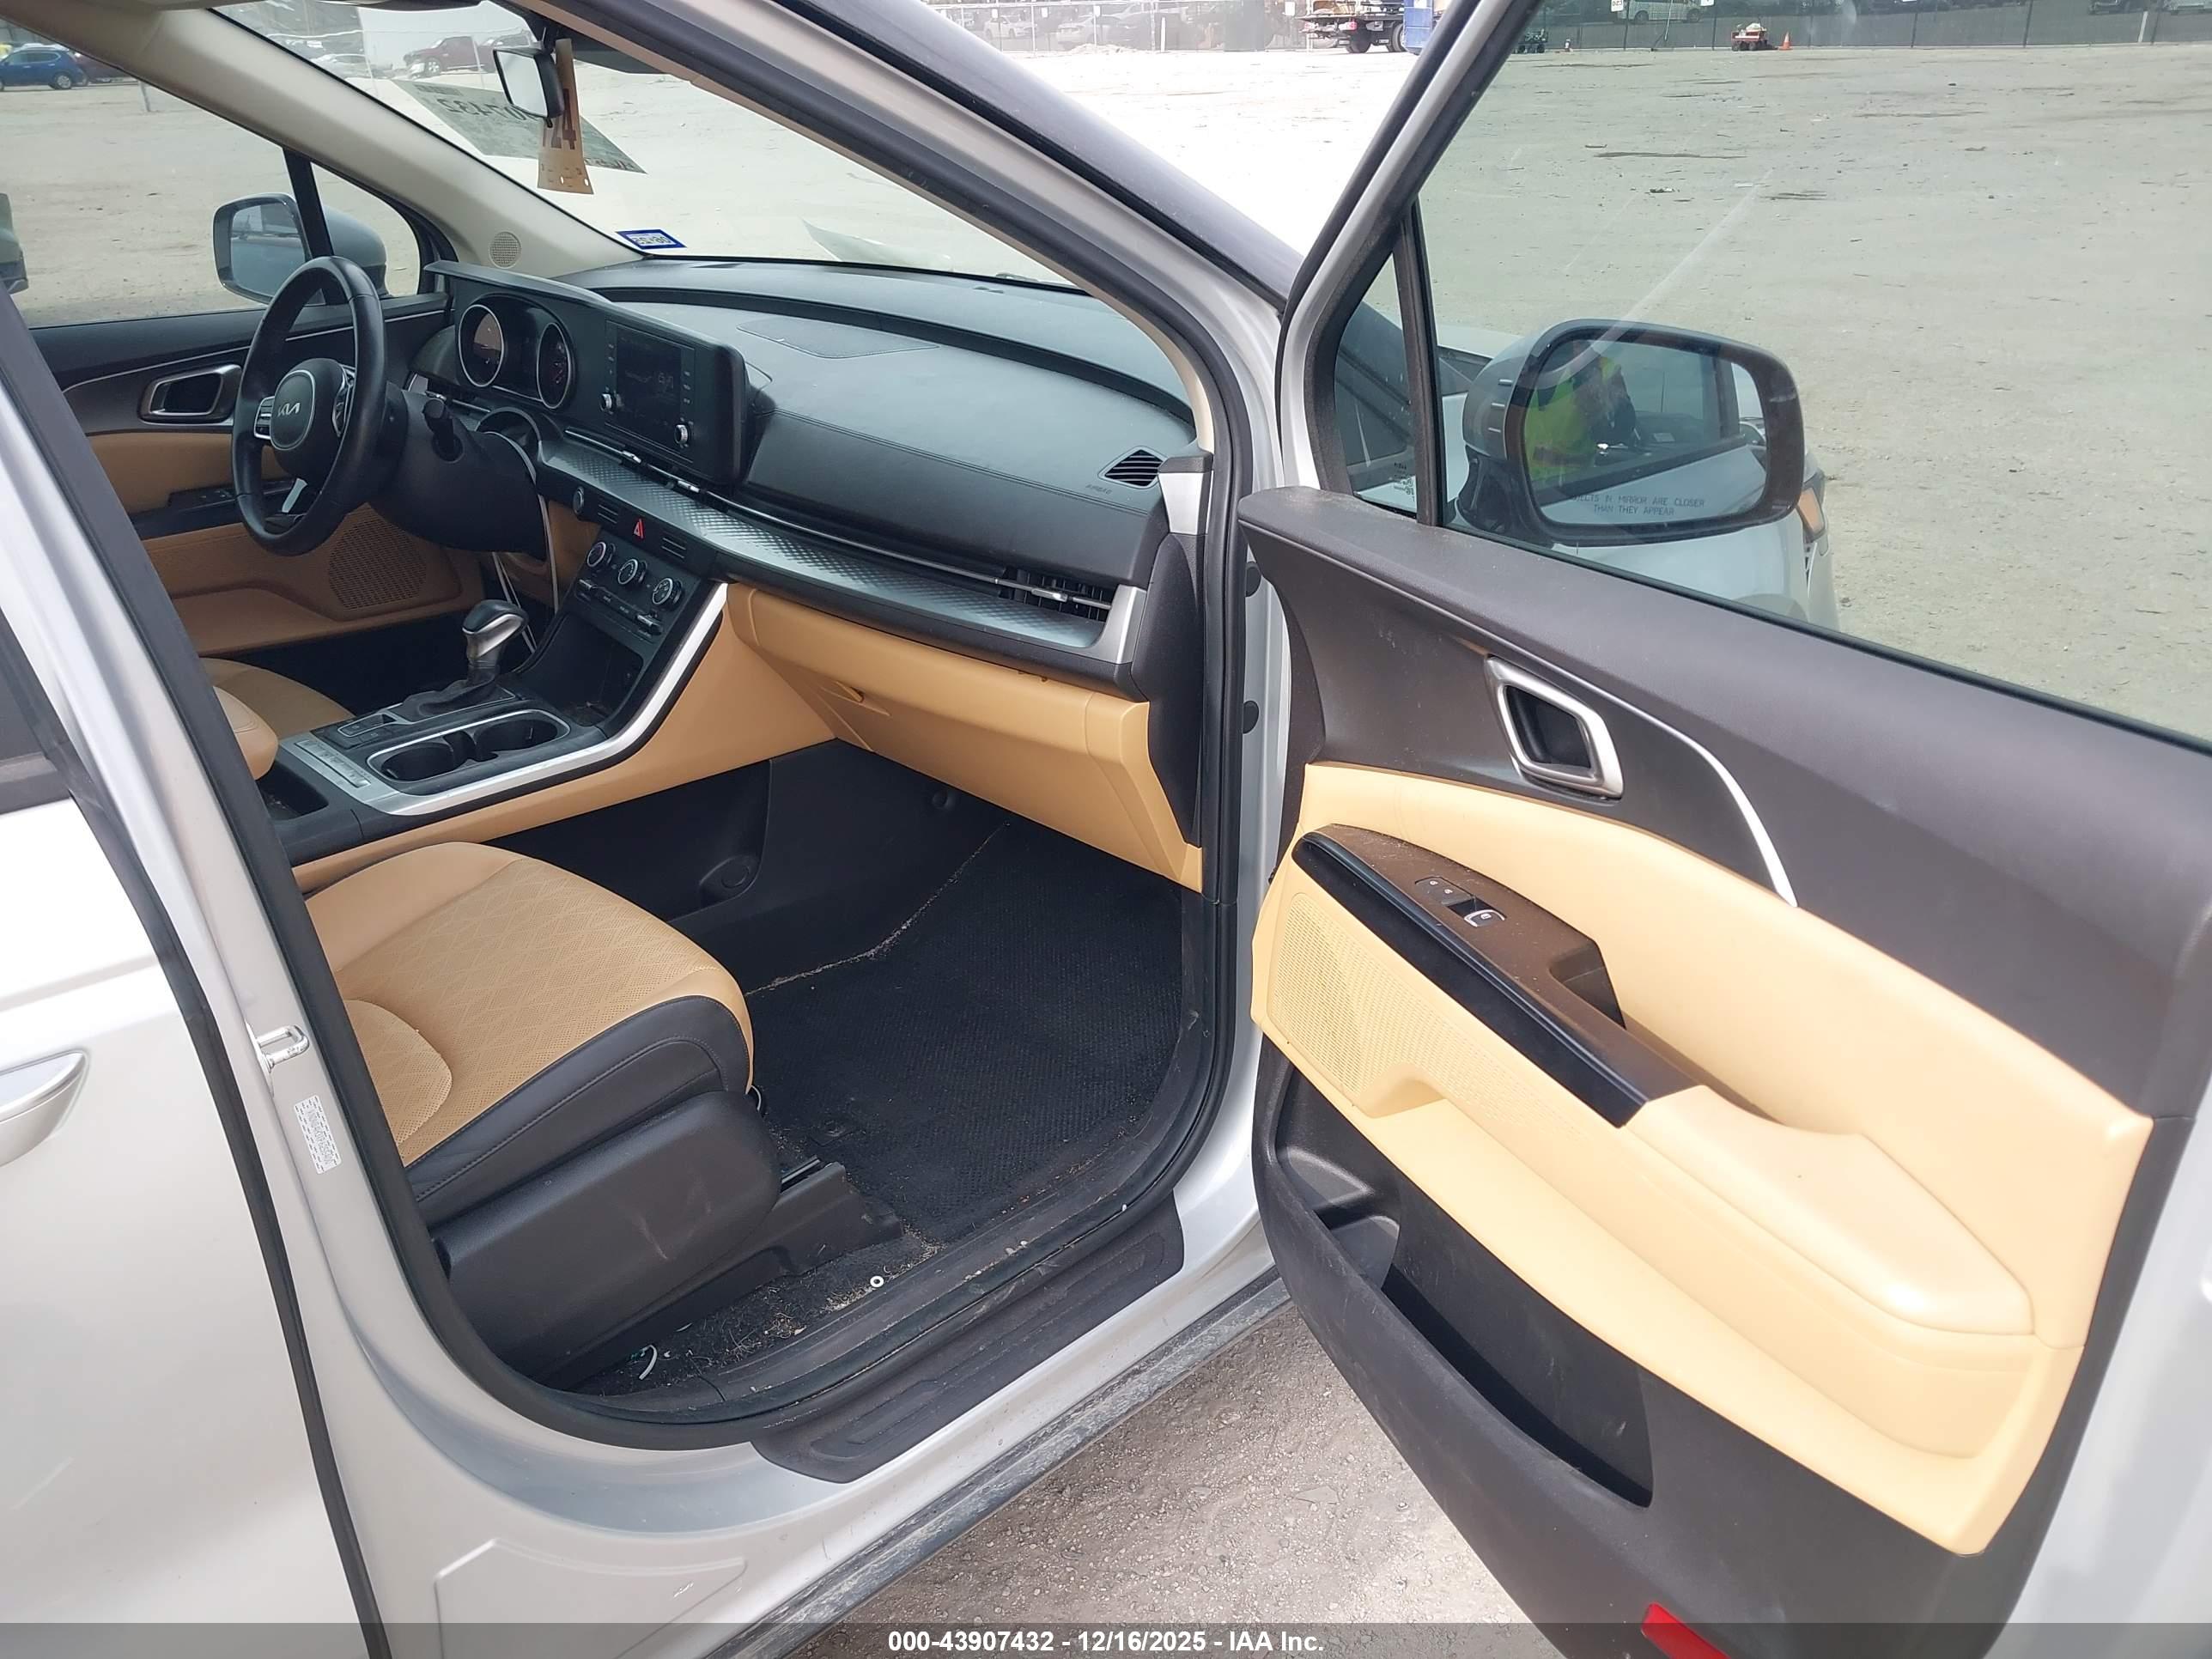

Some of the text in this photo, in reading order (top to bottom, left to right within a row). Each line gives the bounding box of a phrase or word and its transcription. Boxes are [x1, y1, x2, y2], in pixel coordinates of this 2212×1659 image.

[1605, 495, 1613, 503] IN
[1618, 495, 1649, 504] MIRROR
[1652, 496, 1668, 506] ARE
[1674, 498, 1705, 507] CLOSER
[1594, 504, 1675, 515] THAN THEY APPEAR
